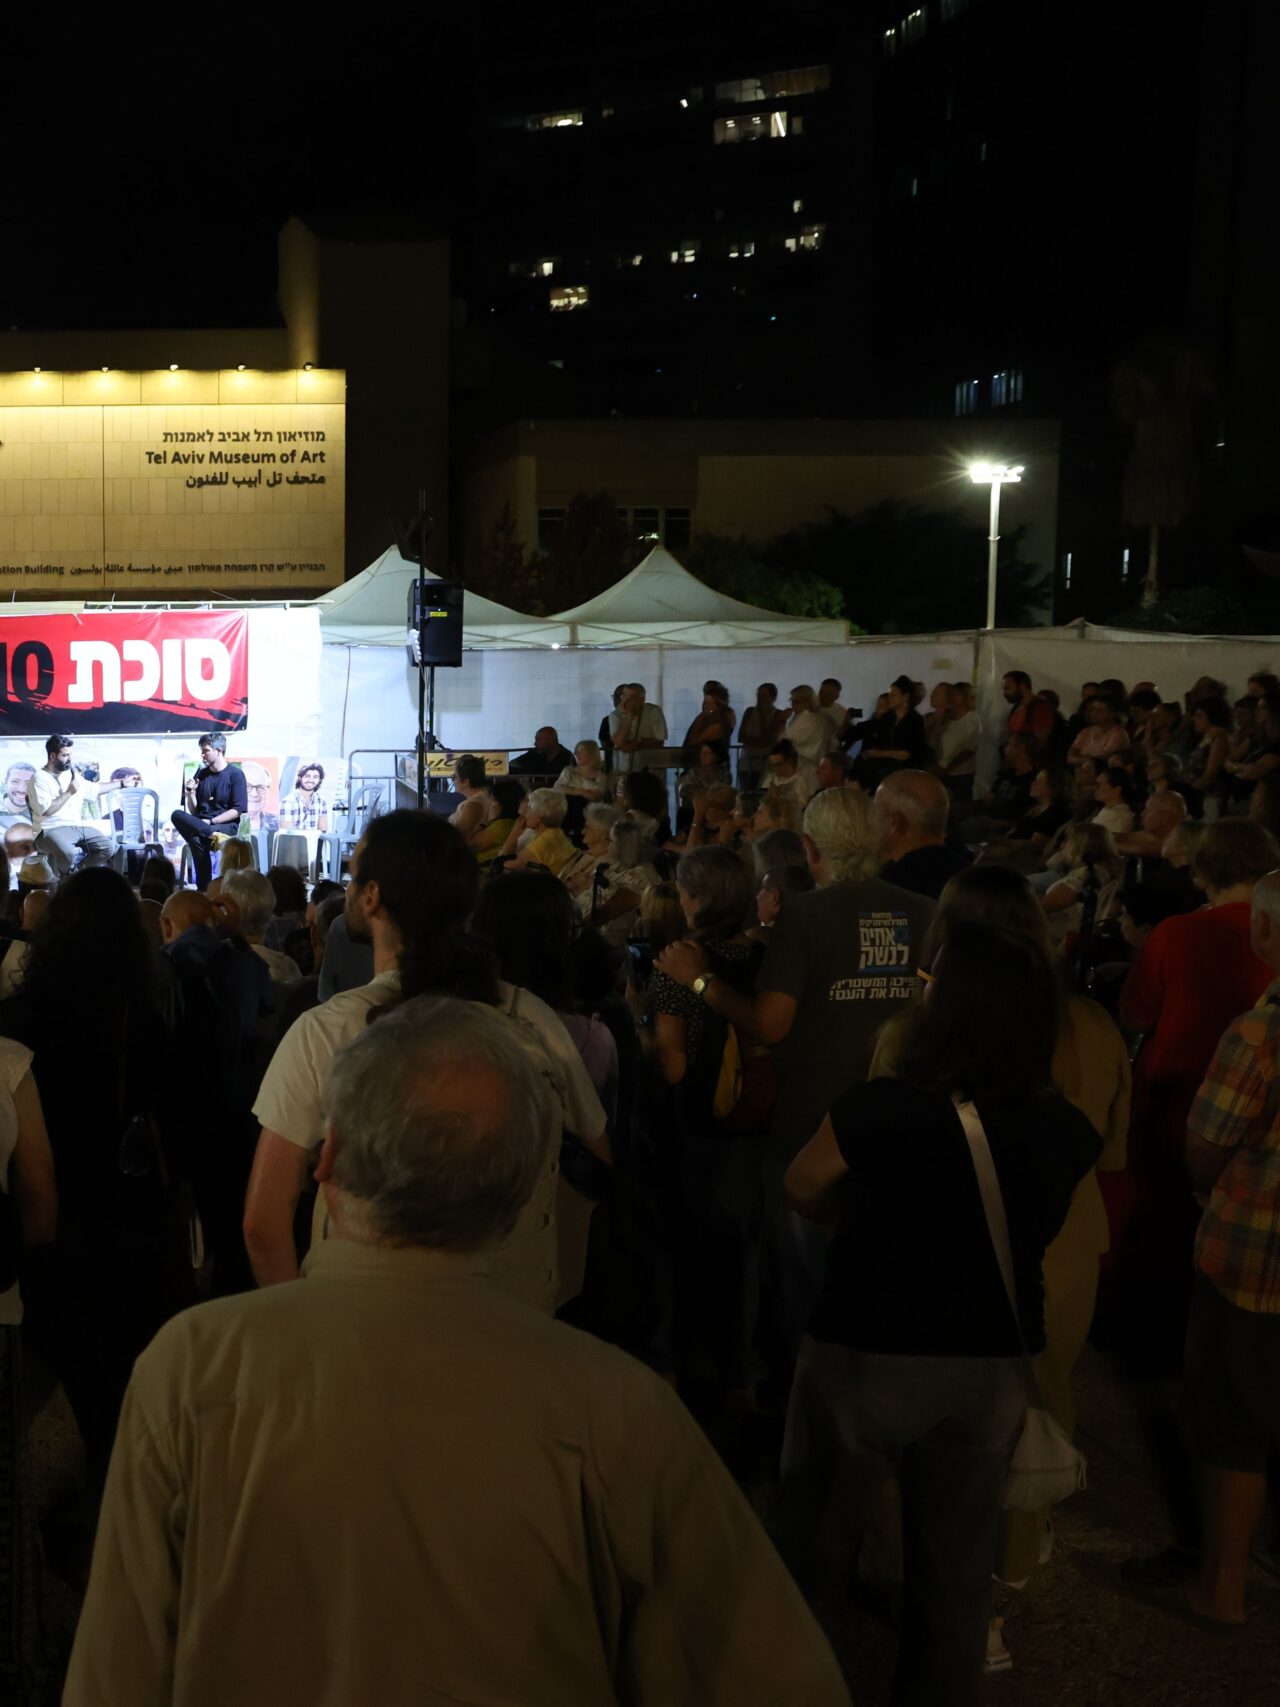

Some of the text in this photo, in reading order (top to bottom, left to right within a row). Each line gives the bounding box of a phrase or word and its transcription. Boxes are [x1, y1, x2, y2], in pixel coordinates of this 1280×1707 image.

[163, 429, 326, 444] מוזיאון תל אביב לאמנות
[145, 449, 326, 464] Tel Aviv Museum of Art
[186, 469, 326, 488] متحف تل أبيب للفنون
[24, 564, 64, 576] Building
[67, 638, 231, 702] סוכת
[859, 927, 896, 946] אחים
[858, 945, 910, 969] לנשק
[831, 977, 887, 989] המשטרית
[828, 988, 867, 1000] העם!
[869, 988, 888, 999] את
